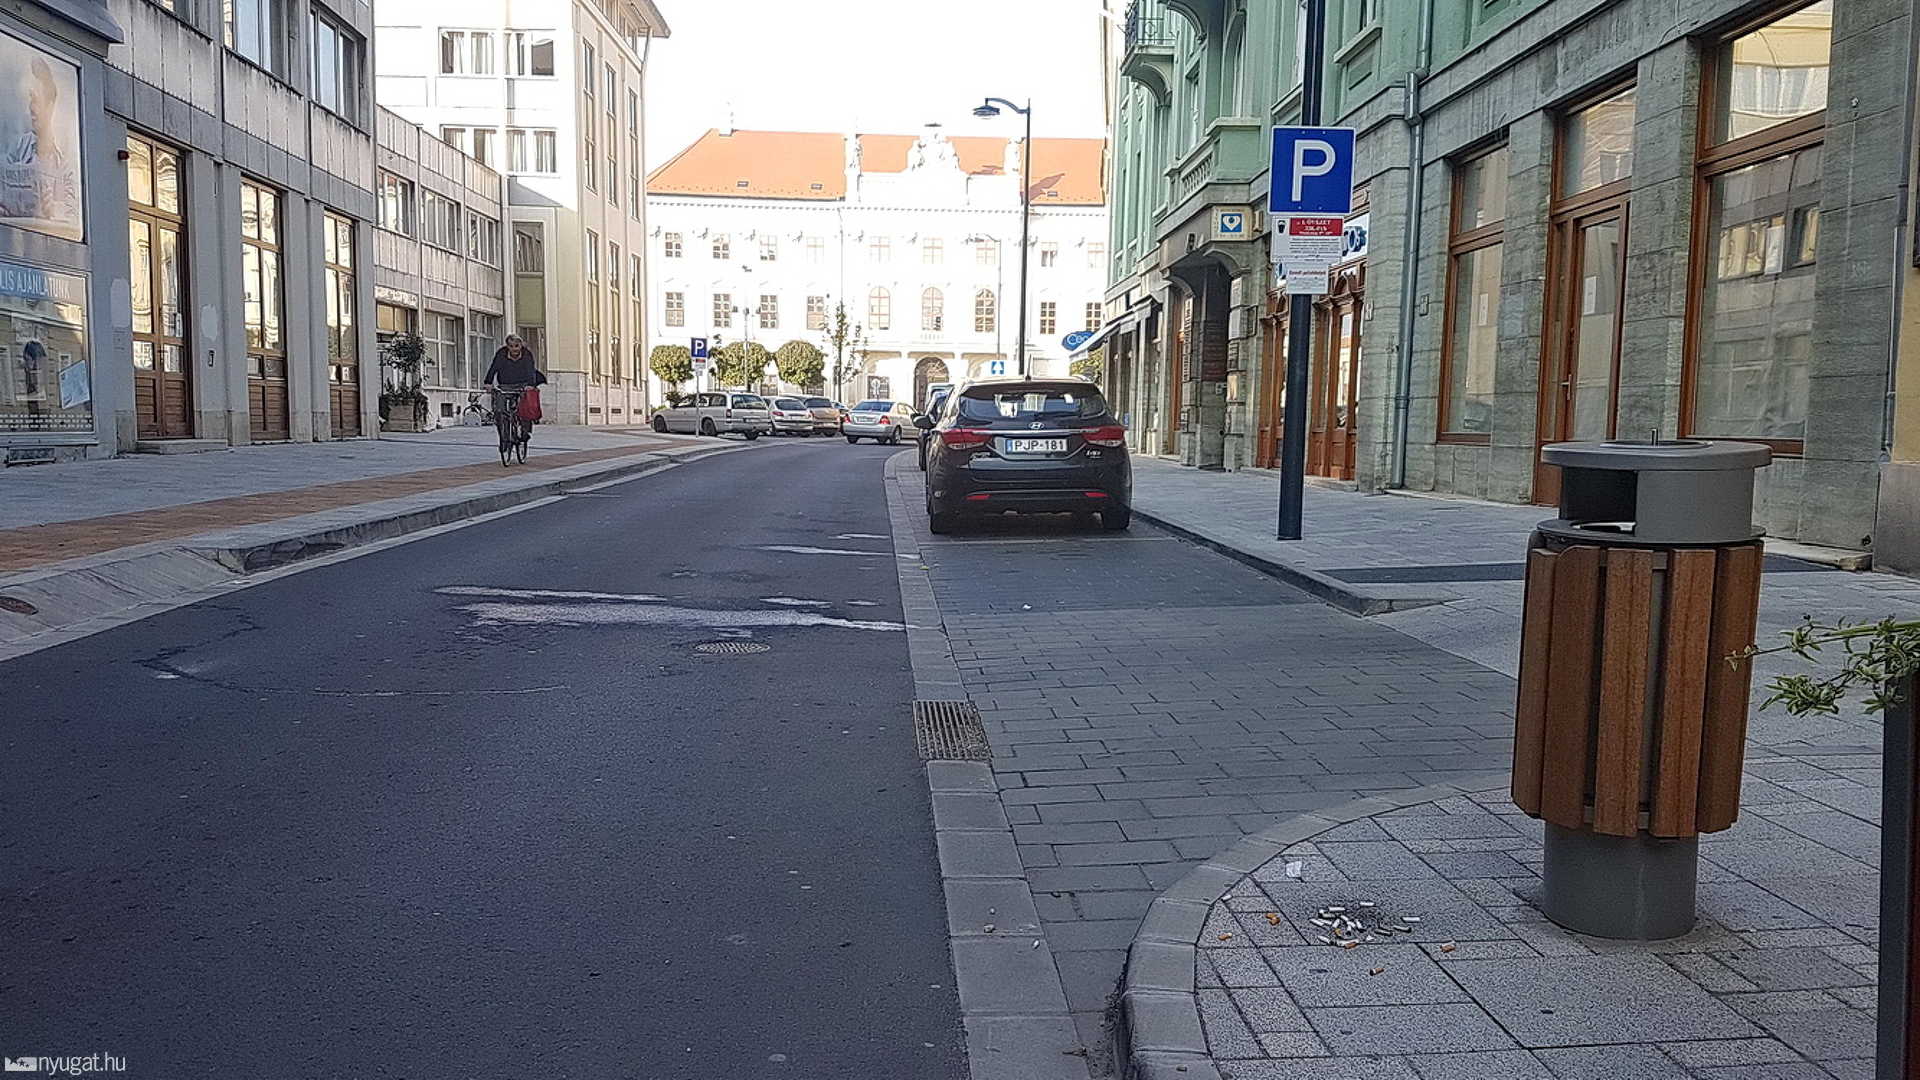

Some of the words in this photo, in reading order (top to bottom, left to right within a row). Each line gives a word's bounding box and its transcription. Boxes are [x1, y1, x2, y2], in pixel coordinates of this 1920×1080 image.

[1291, 139, 1336, 202] P
[694, 339, 705, 355] P
[1014, 440, 1064, 451] PJP-181
